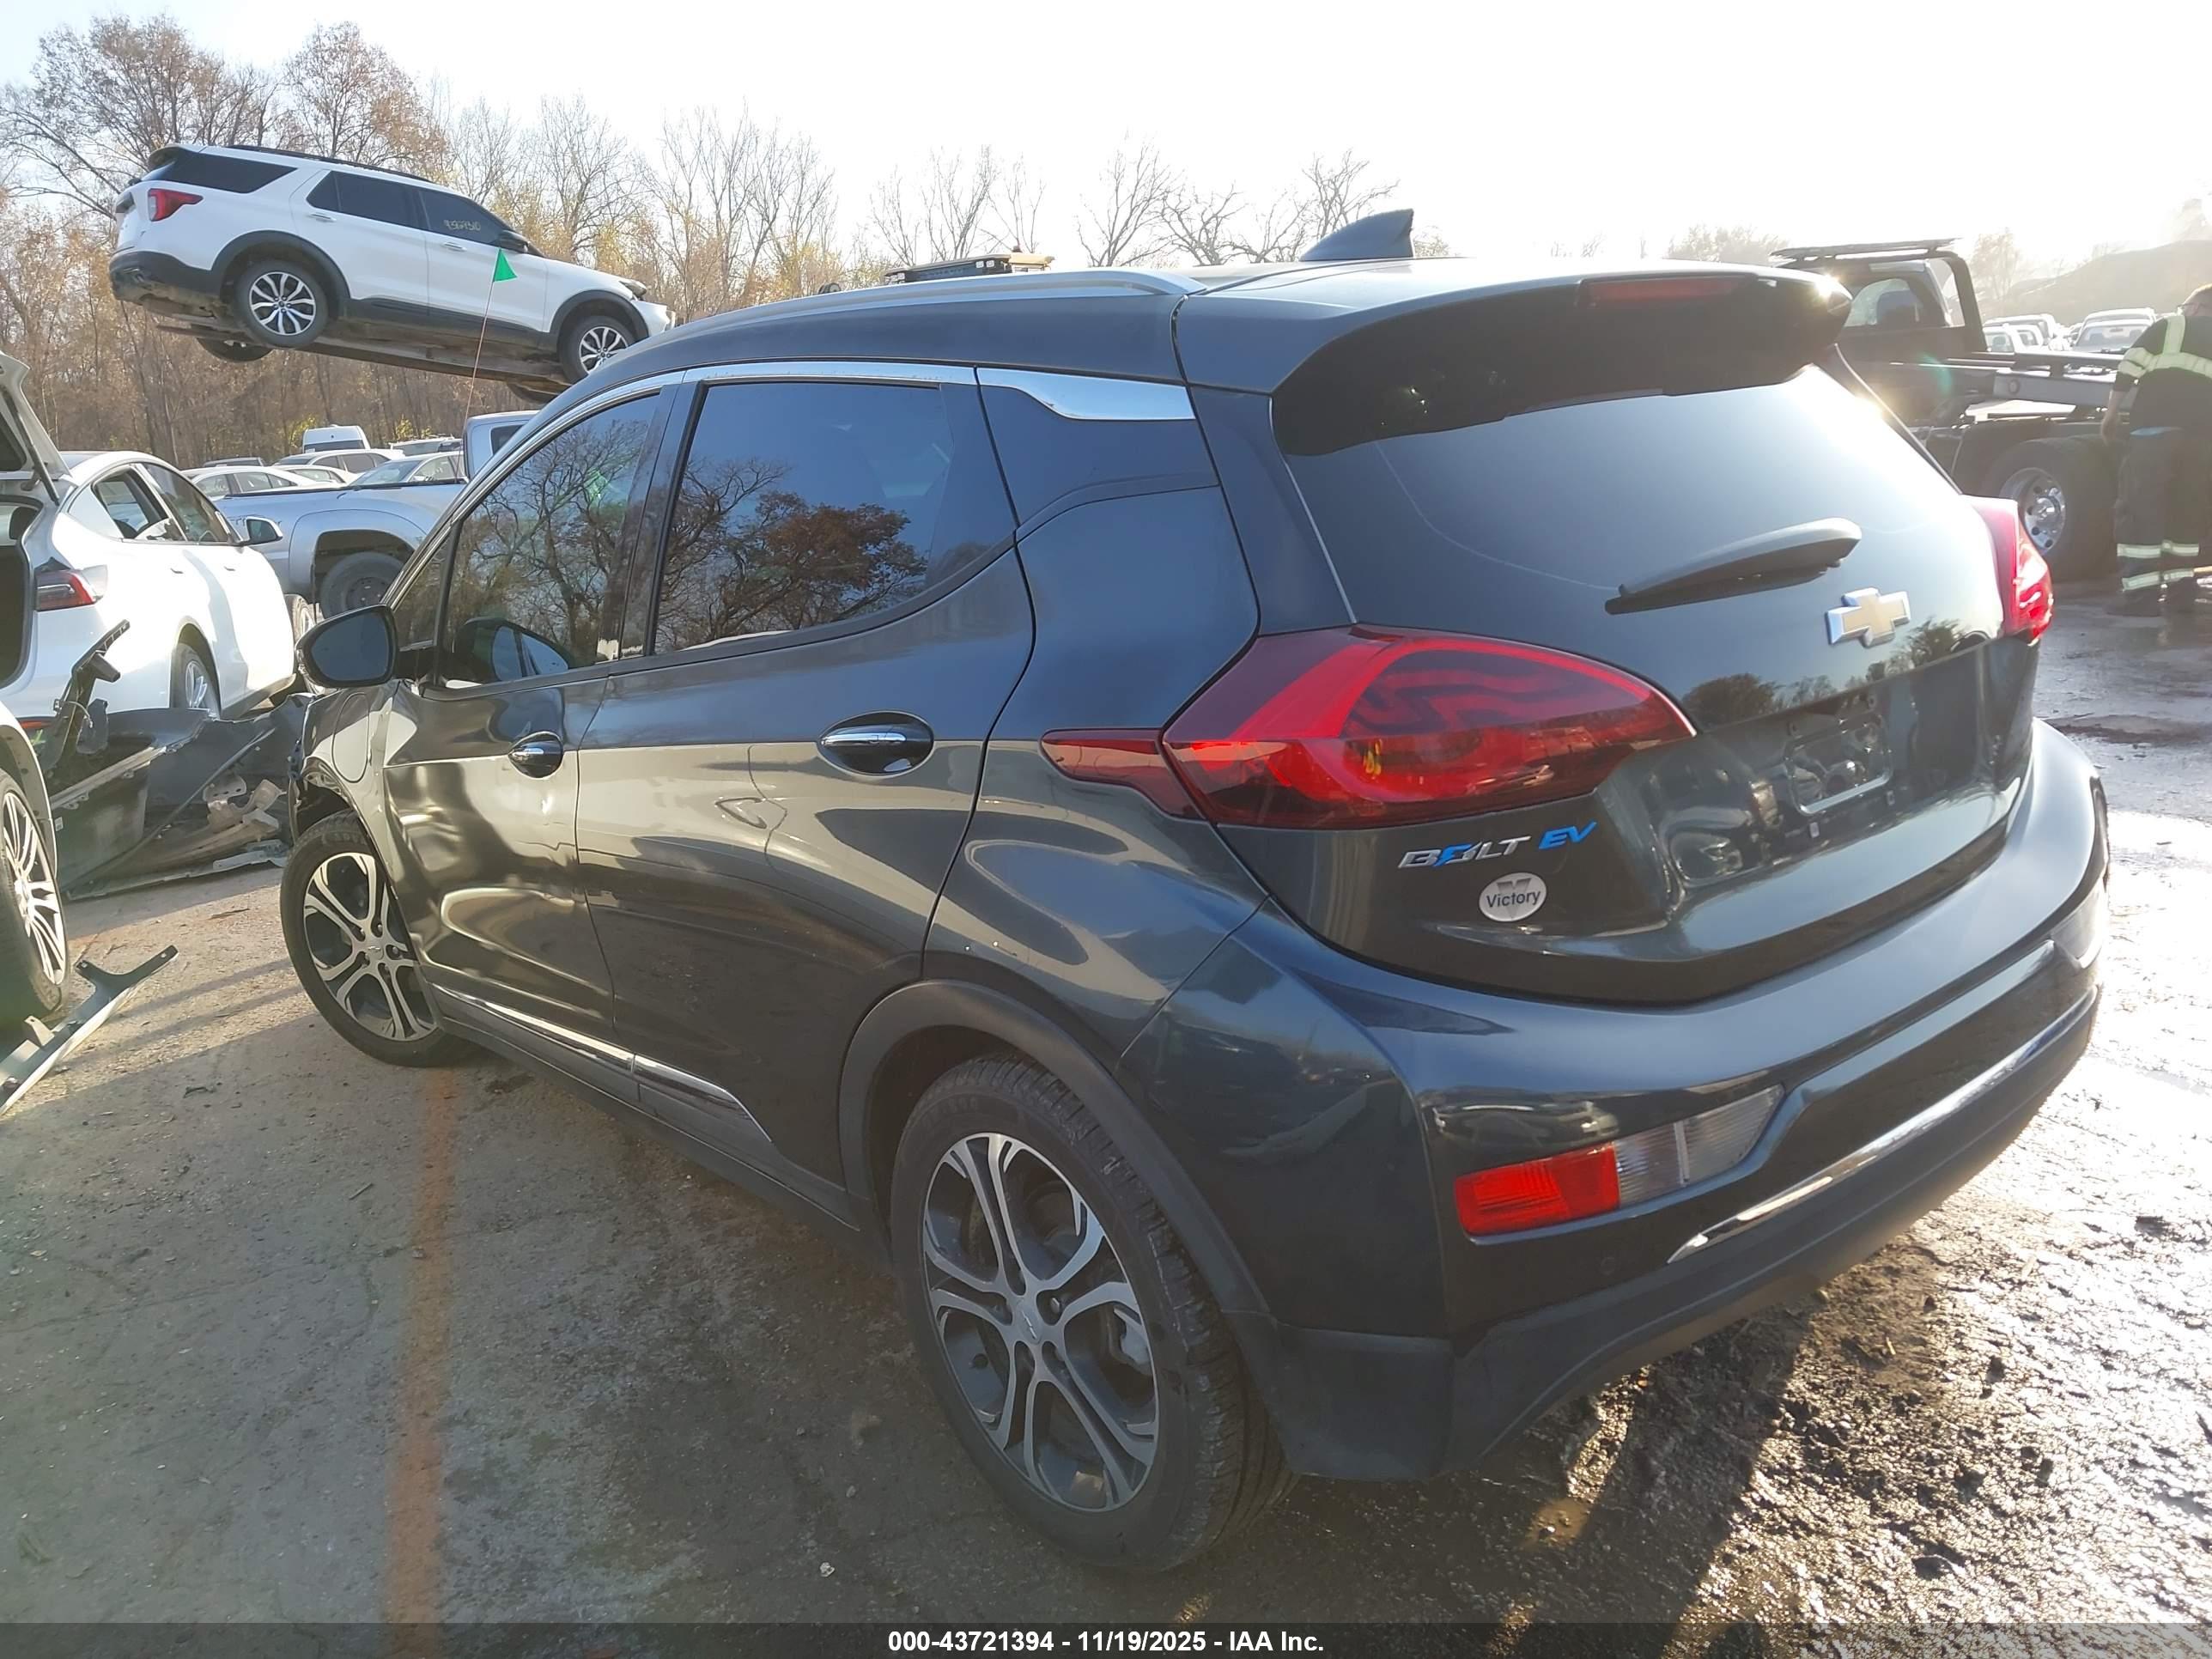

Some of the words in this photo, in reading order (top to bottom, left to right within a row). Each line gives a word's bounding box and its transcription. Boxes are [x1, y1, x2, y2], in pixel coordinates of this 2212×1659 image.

[1398, 836, 1532, 868] BOLT
[1538, 820, 1598, 850] EV
[1486, 890, 1541, 908] Victory
